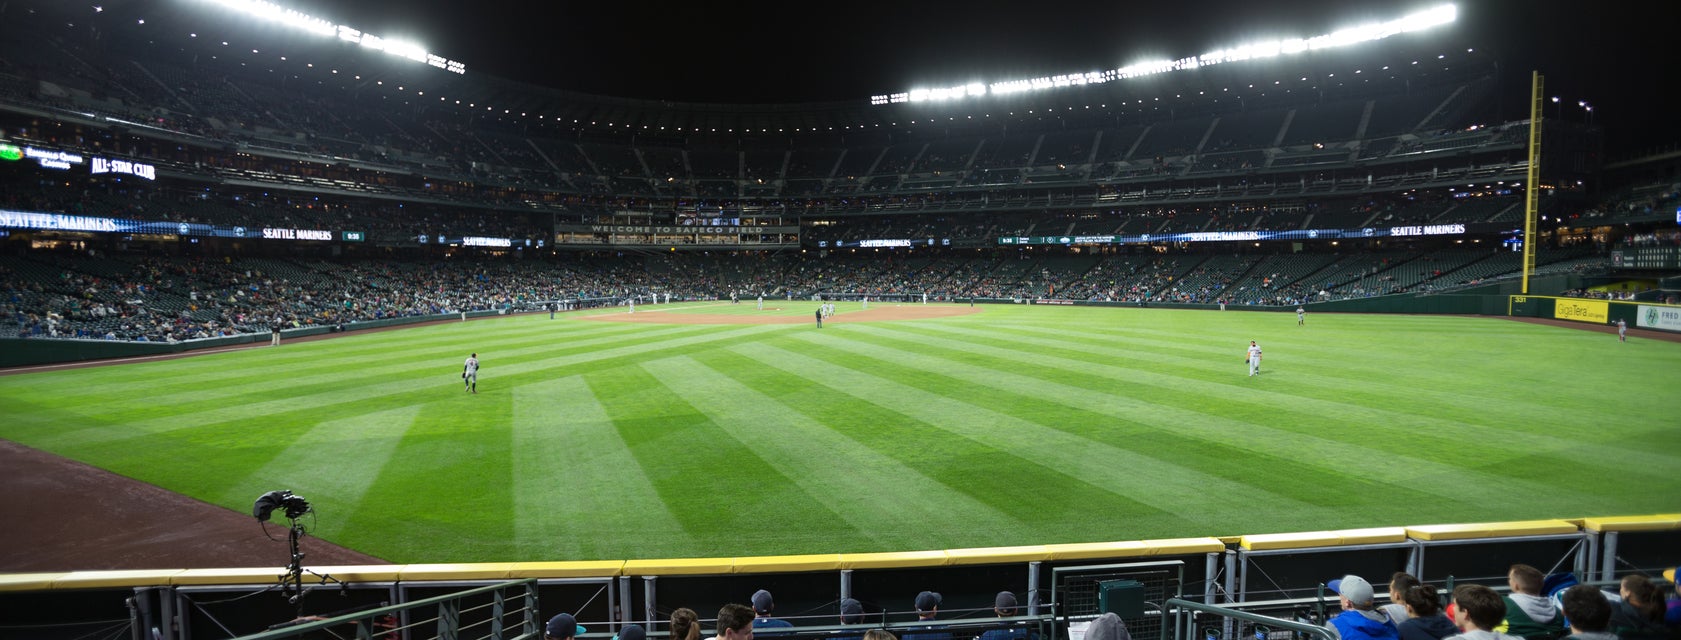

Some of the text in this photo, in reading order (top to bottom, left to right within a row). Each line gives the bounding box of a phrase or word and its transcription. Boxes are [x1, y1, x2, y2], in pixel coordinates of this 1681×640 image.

[133, 163, 155, 180] CLUB
[0, 211, 116, 231] SEATTLE MARINERS
[263, 228, 332, 240] SEATTLE MARINERS
[1222, 231, 1258, 241] MARINERS
[1391, 224, 1465, 236] SEATTLE MARINERS
[1558, 303, 1587, 318] GigaTera
[1661, 311, 1679, 320] FRED
